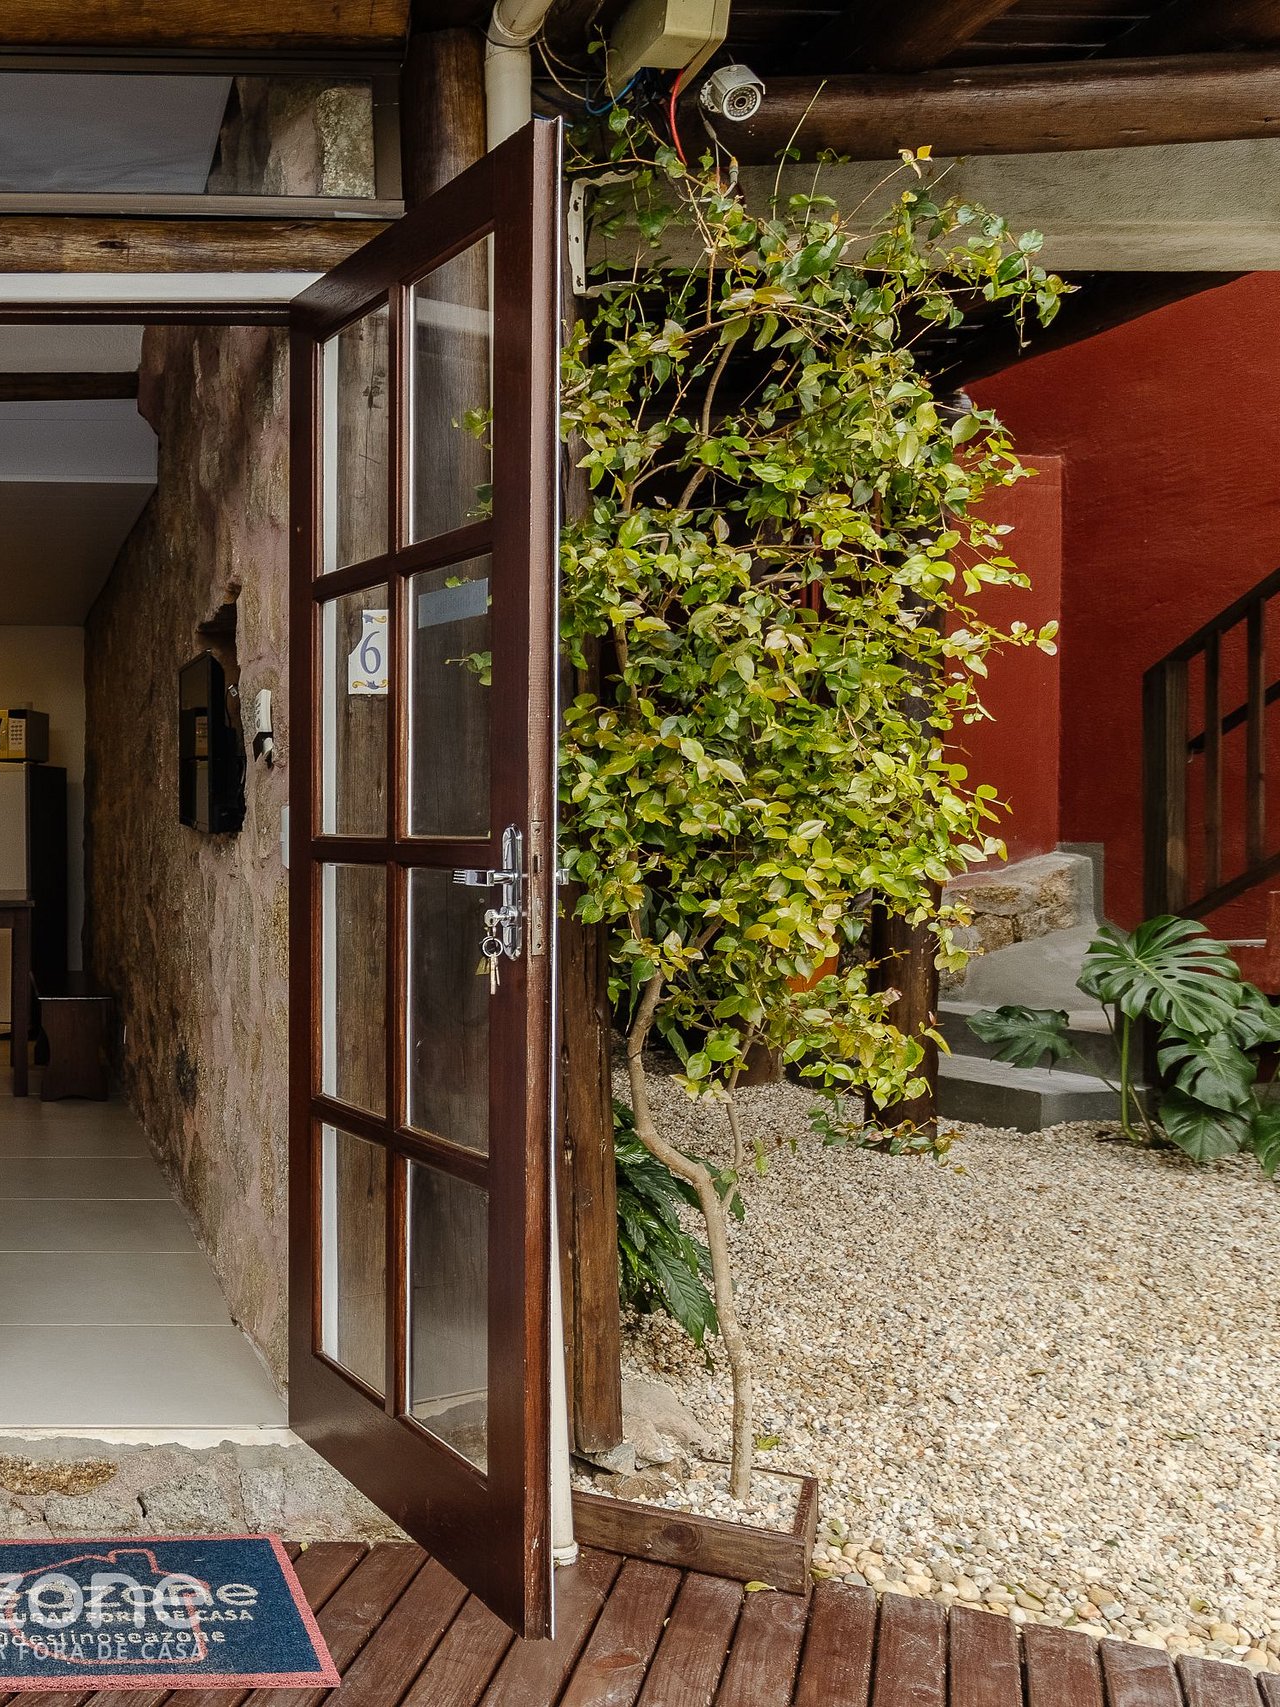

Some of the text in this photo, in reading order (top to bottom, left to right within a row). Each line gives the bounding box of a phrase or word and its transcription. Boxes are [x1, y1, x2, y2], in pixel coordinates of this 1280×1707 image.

[360, 631, 381, 674] 6
[0, 1612, 76, 1624] LUGAR
[195, 1609, 254, 1621] CASA
